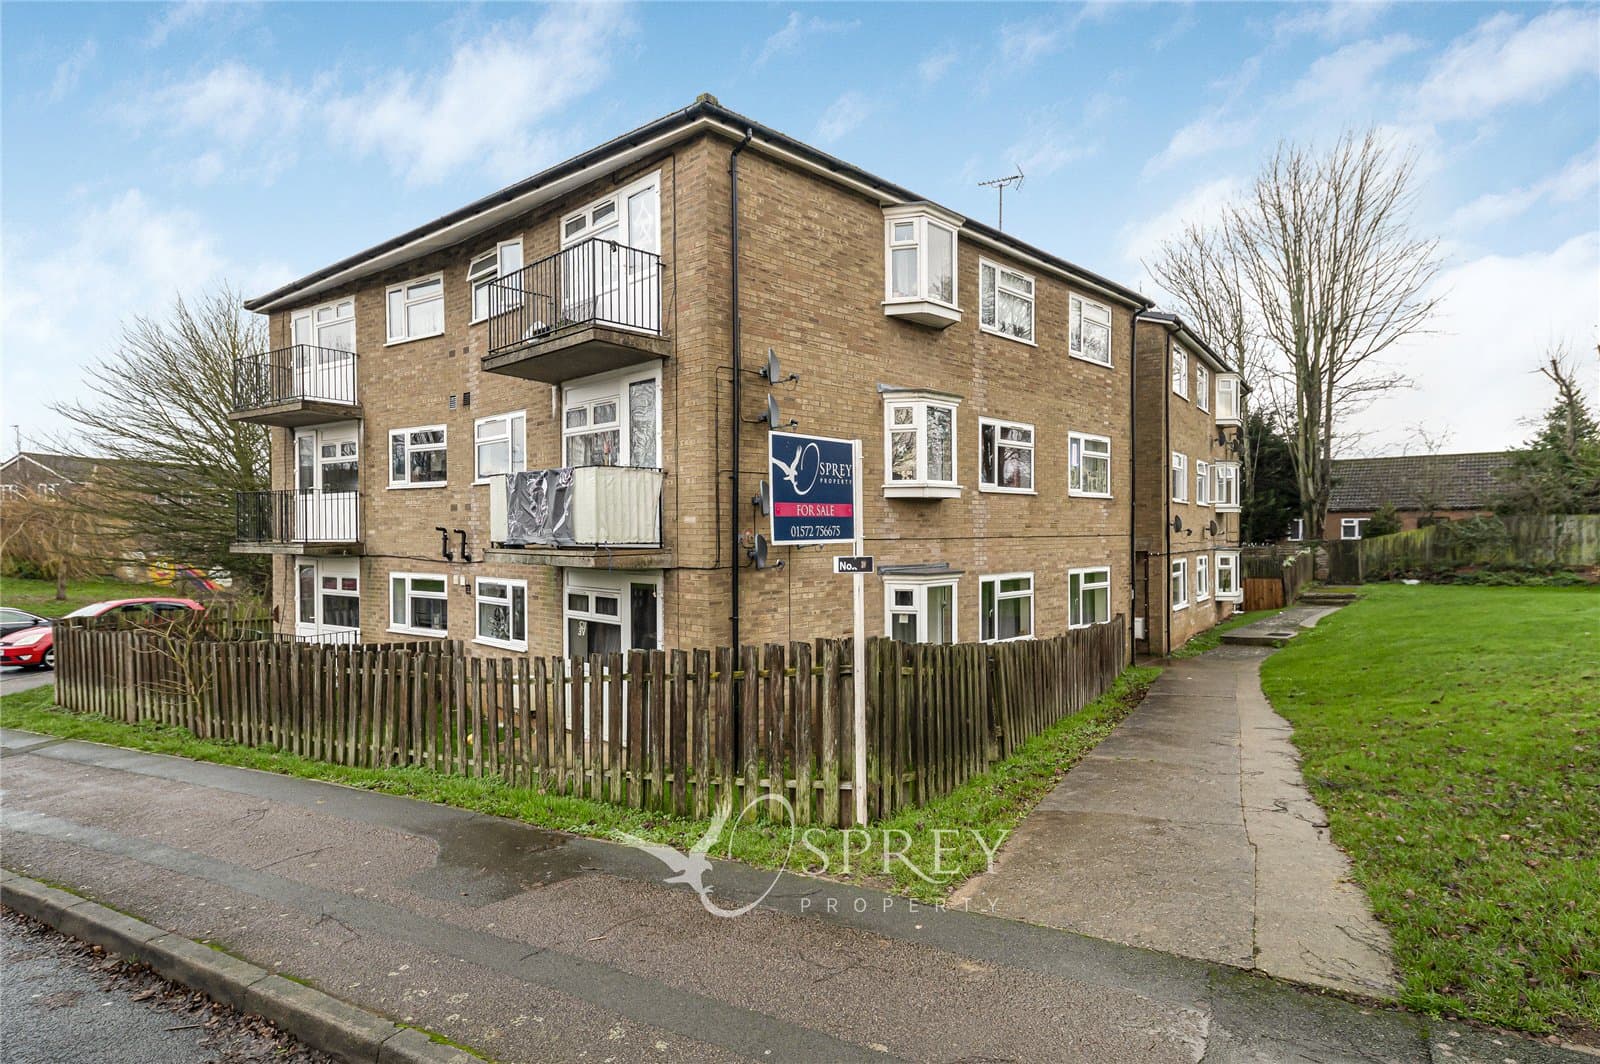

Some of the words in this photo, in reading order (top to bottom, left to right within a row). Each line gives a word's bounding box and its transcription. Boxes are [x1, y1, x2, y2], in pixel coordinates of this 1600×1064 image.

[797, 504, 815, 516] FOR
[816, 505, 835, 516] SALE
[790, 525, 814, 537] 01572
[815, 525, 841, 537] 756675
